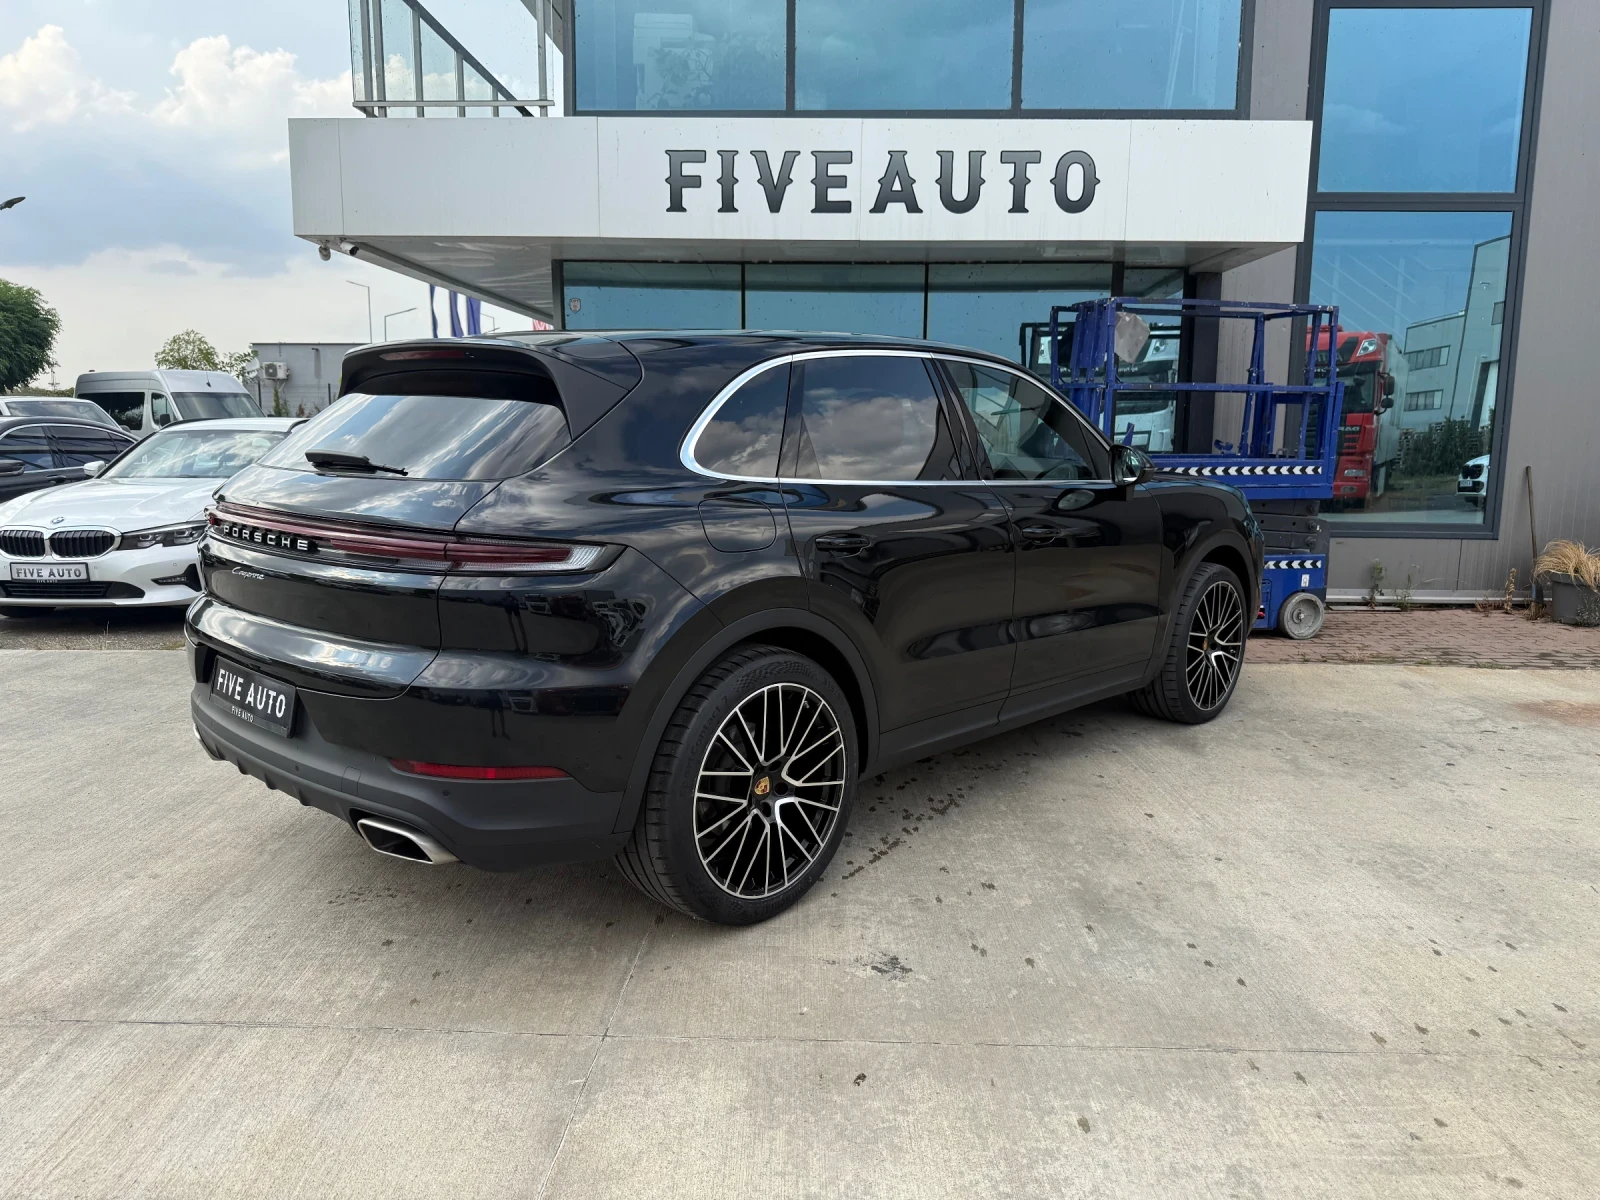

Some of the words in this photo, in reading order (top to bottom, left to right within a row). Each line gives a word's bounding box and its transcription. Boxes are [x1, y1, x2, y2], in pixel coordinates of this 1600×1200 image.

[223, 525, 309, 551] PORSCHE
[16, 567, 43, 578] FIVE
[48, 567, 82, 578] AUTO
[231, 566, 265, 579] Cayenne
[216, 668, 244, 701] FIVE
[245, 682, 286, 718] AUTO
[231, 705, 241, 717] FIVE
[241, 711, 254, 723] AUTO
